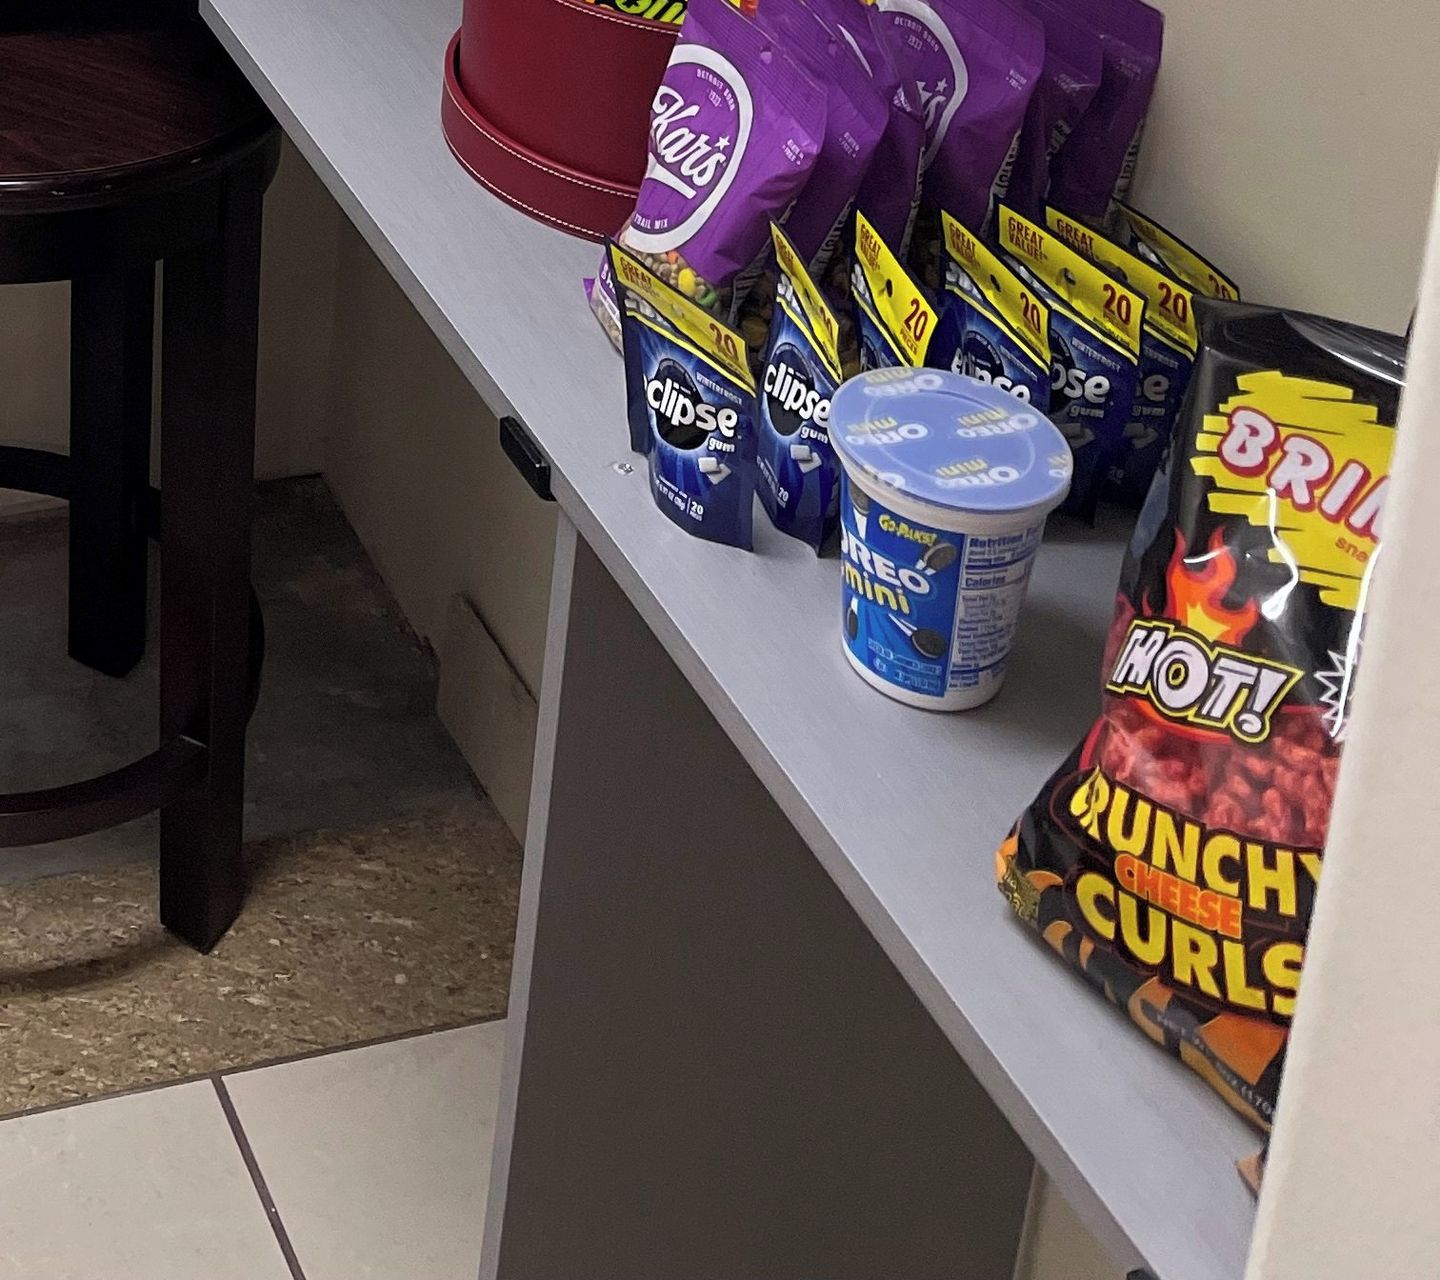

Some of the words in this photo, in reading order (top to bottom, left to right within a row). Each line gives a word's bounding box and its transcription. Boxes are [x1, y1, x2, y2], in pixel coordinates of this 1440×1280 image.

[696, 68, 724, 90] DETROIT
[652, 85, 728, 186] Kar's
[634, 214, 651, 229] TRAIL
[654, 218, 668, 229] MIX
[949, 221, 976, 256] GREAT
[1008, 216, 1045, 249] GREAT
[1056, 217, 1094, 252] GREAT
[860, 223, 882, 255] GREAT
[1020, 290, 1040, 335] 20
[1103, 283, 1132, 326] 20
[1158, 281, 1188, 324] 20
[904, 298, 929, 342] 20
[1071, 336, 1121, 372] WINTERFROST
[696, 371, 742, 405] WINTERFROST
[1069, 404, 1104, 418] gum
[709, 436, 735, 452] gum
[801, 426, 828, 443] gum
[691, 501, 703, 515] 20
[778, 487, 789, 502] 20
[1112, 624, 1296, 738] HOT!
[1115, 852, 1243, 939] CHEESE
